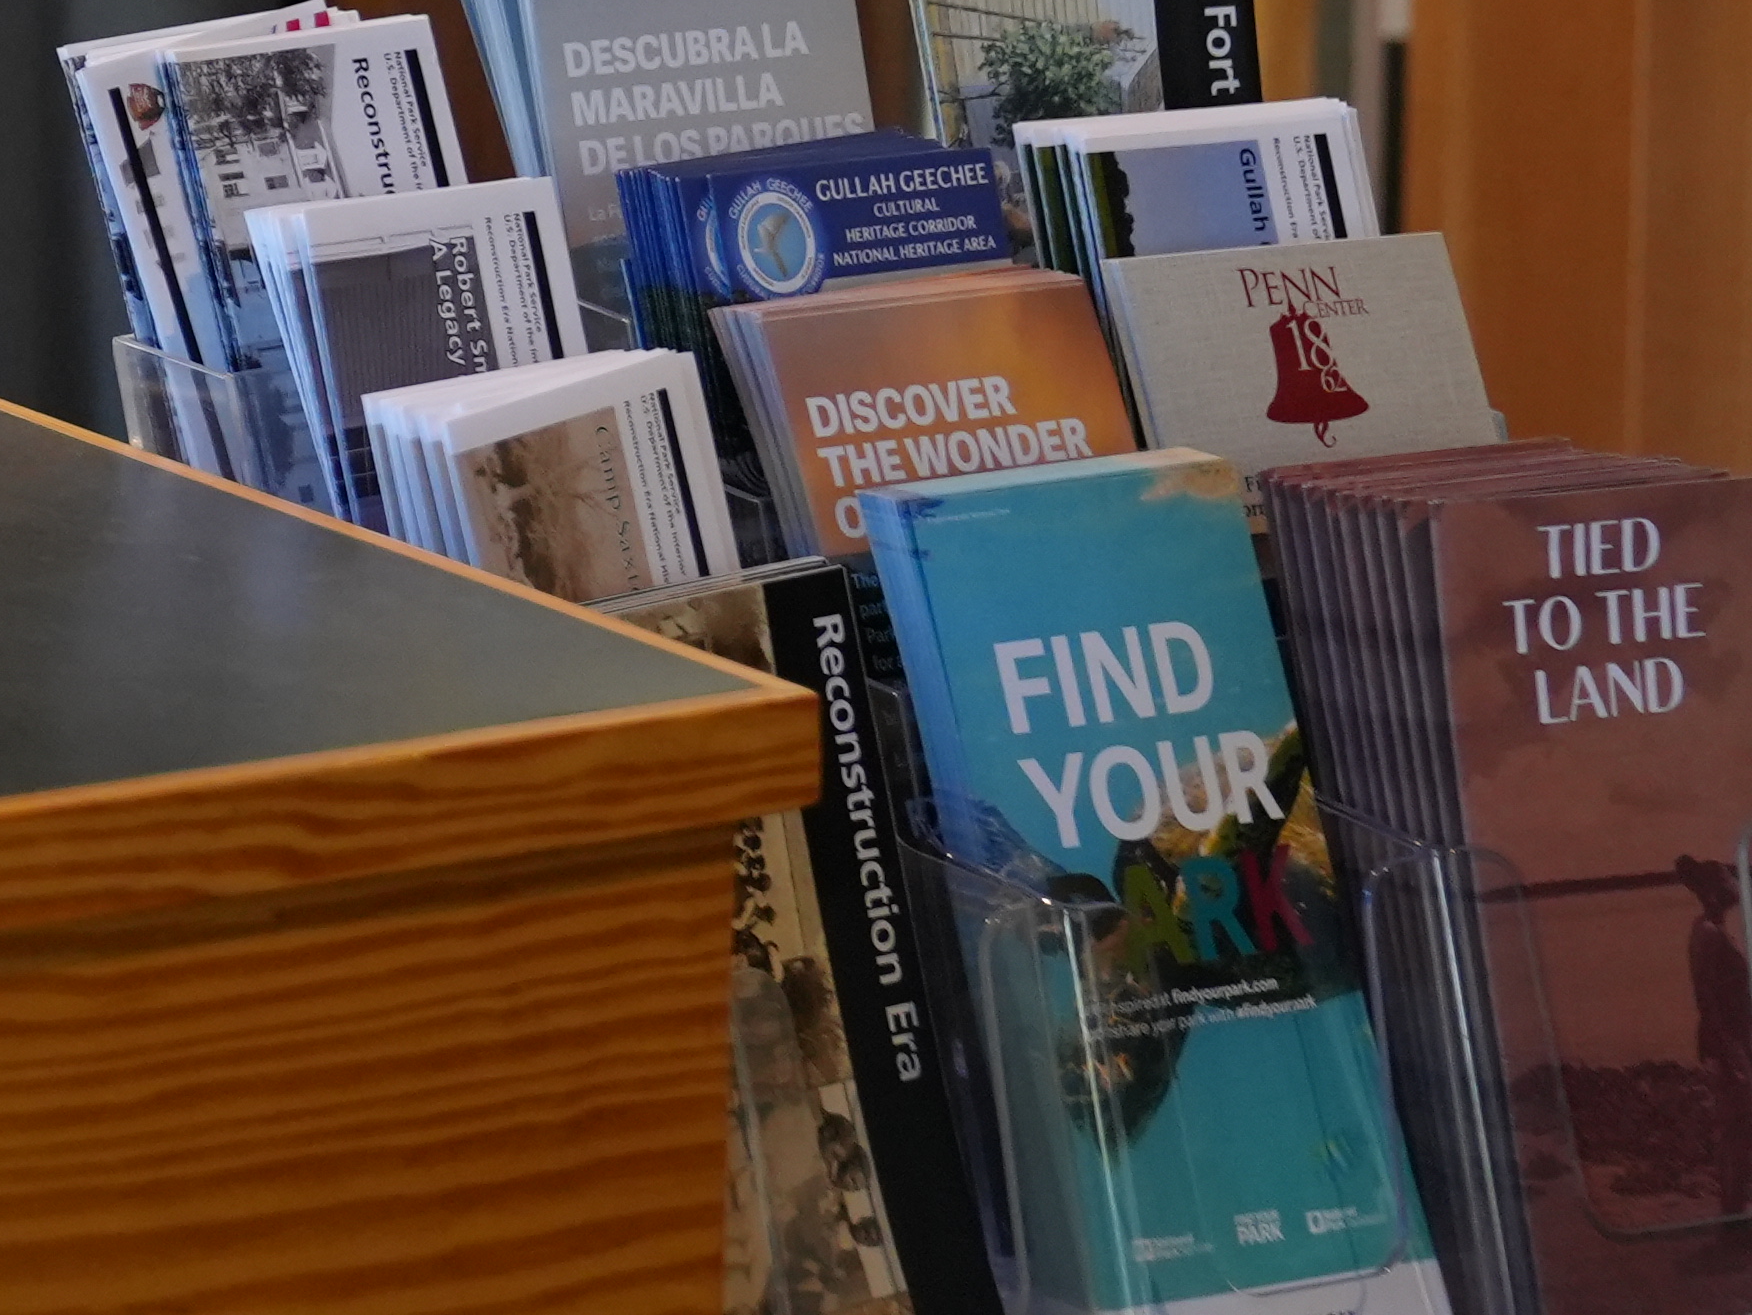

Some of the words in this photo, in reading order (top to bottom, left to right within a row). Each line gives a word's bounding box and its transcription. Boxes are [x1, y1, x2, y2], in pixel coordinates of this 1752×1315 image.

[384, 52, 395, 75] U.S.
[562, 25, 759, 78] DESCUBRA
[761, 20, 811, 61] LA
[1204, 5, 1241, 97] Fort
[393, 51, 413, 99] National
[570, 71, 785, 127] MARAVILLA
[389, 77, 412, 144] Department
[406, 100, 419, 125] Park
[407, 146, 417, 161] of
[410, 162, 420, 181] the
[412, 127, 427, 168] Service
[578, 136, 630, 175] DE
[632, 128, 705, 168] LOS
[1303, 134, 1320, 182] National
[1312, 183, 1324, 207] Park
[728, 179, 763, 220] GULLAH
[765, 177, 814, 213] GEECHEE
[815, 172, 897, 202] GULLAH
[899, 162, 990, 193] GEECHEE
[1239, 148, 1270, 232] Gullah
[1298, 159, 1319, 226] Department
[845, 221, 906, 243] HERITAGE
[908, 215, 978, 236] CORRIDOR
[873, 196, 941, 218] CULTURAL
[428, 237, 448, 262] A
[484, 216, 505, 303] Reconstruction
[512, 212, 530, 261] National
[832, 247, 899, 267] NATIONAL
[899, 238, 963, 259] HERITAGE
[963, 235, 997, 253] AREA
[449, 236, 482, 333] Robert
[508, 240, 528, 309] Department
[523, 263, 536, 289] Park
[1235, 266, 1343, 313] PENN
[435, 269, 467, 366] Legacy
[501, 304, 512, 321] Era
[523, 311, 532, 326] of
[529, 290, 543, 334] Service
[1302, 298, 1370, 319] CENTER
[505, 325, 519, 366] Nation
[526, 327, 535, 346] the
[805, 374, 1018, 439] DISCOVER
[623, 399, 647, 488] Reconstruction
[645, 421, 668, 492] Department
[648, 392, 666, 442] National
[659, 443, 671, 469] Park
[666, 470, 681, 515] Service
[816, 436, 907, 488] THE
[903, 416, 1094, 480] WONDER
[596, 425, 622, 511] Camp
[644, 490, 654, 509] Era
[662, 494, 673, 509] of
[666, 509, 675, 530] the
[648, 510, 666, 562] National
[671, 530, 688, 577] Interior
[1536, 516, 1662, 579] TIED
[1501, 595, 1583, 656] TO
[1594, 582, 1707, 645] THE
[992, 620, 1215, 736] FIND
[1533, 656, 1686, 725] LAND
[1017, 729, 1286, 849] YOUR
[813, 612, 905, 987] Reconstruction
[884, 1000, 922, 1083] Era
[1118, 842, 1316, 966] ARK
[1235, 1221, 1287, 1247] PARK
